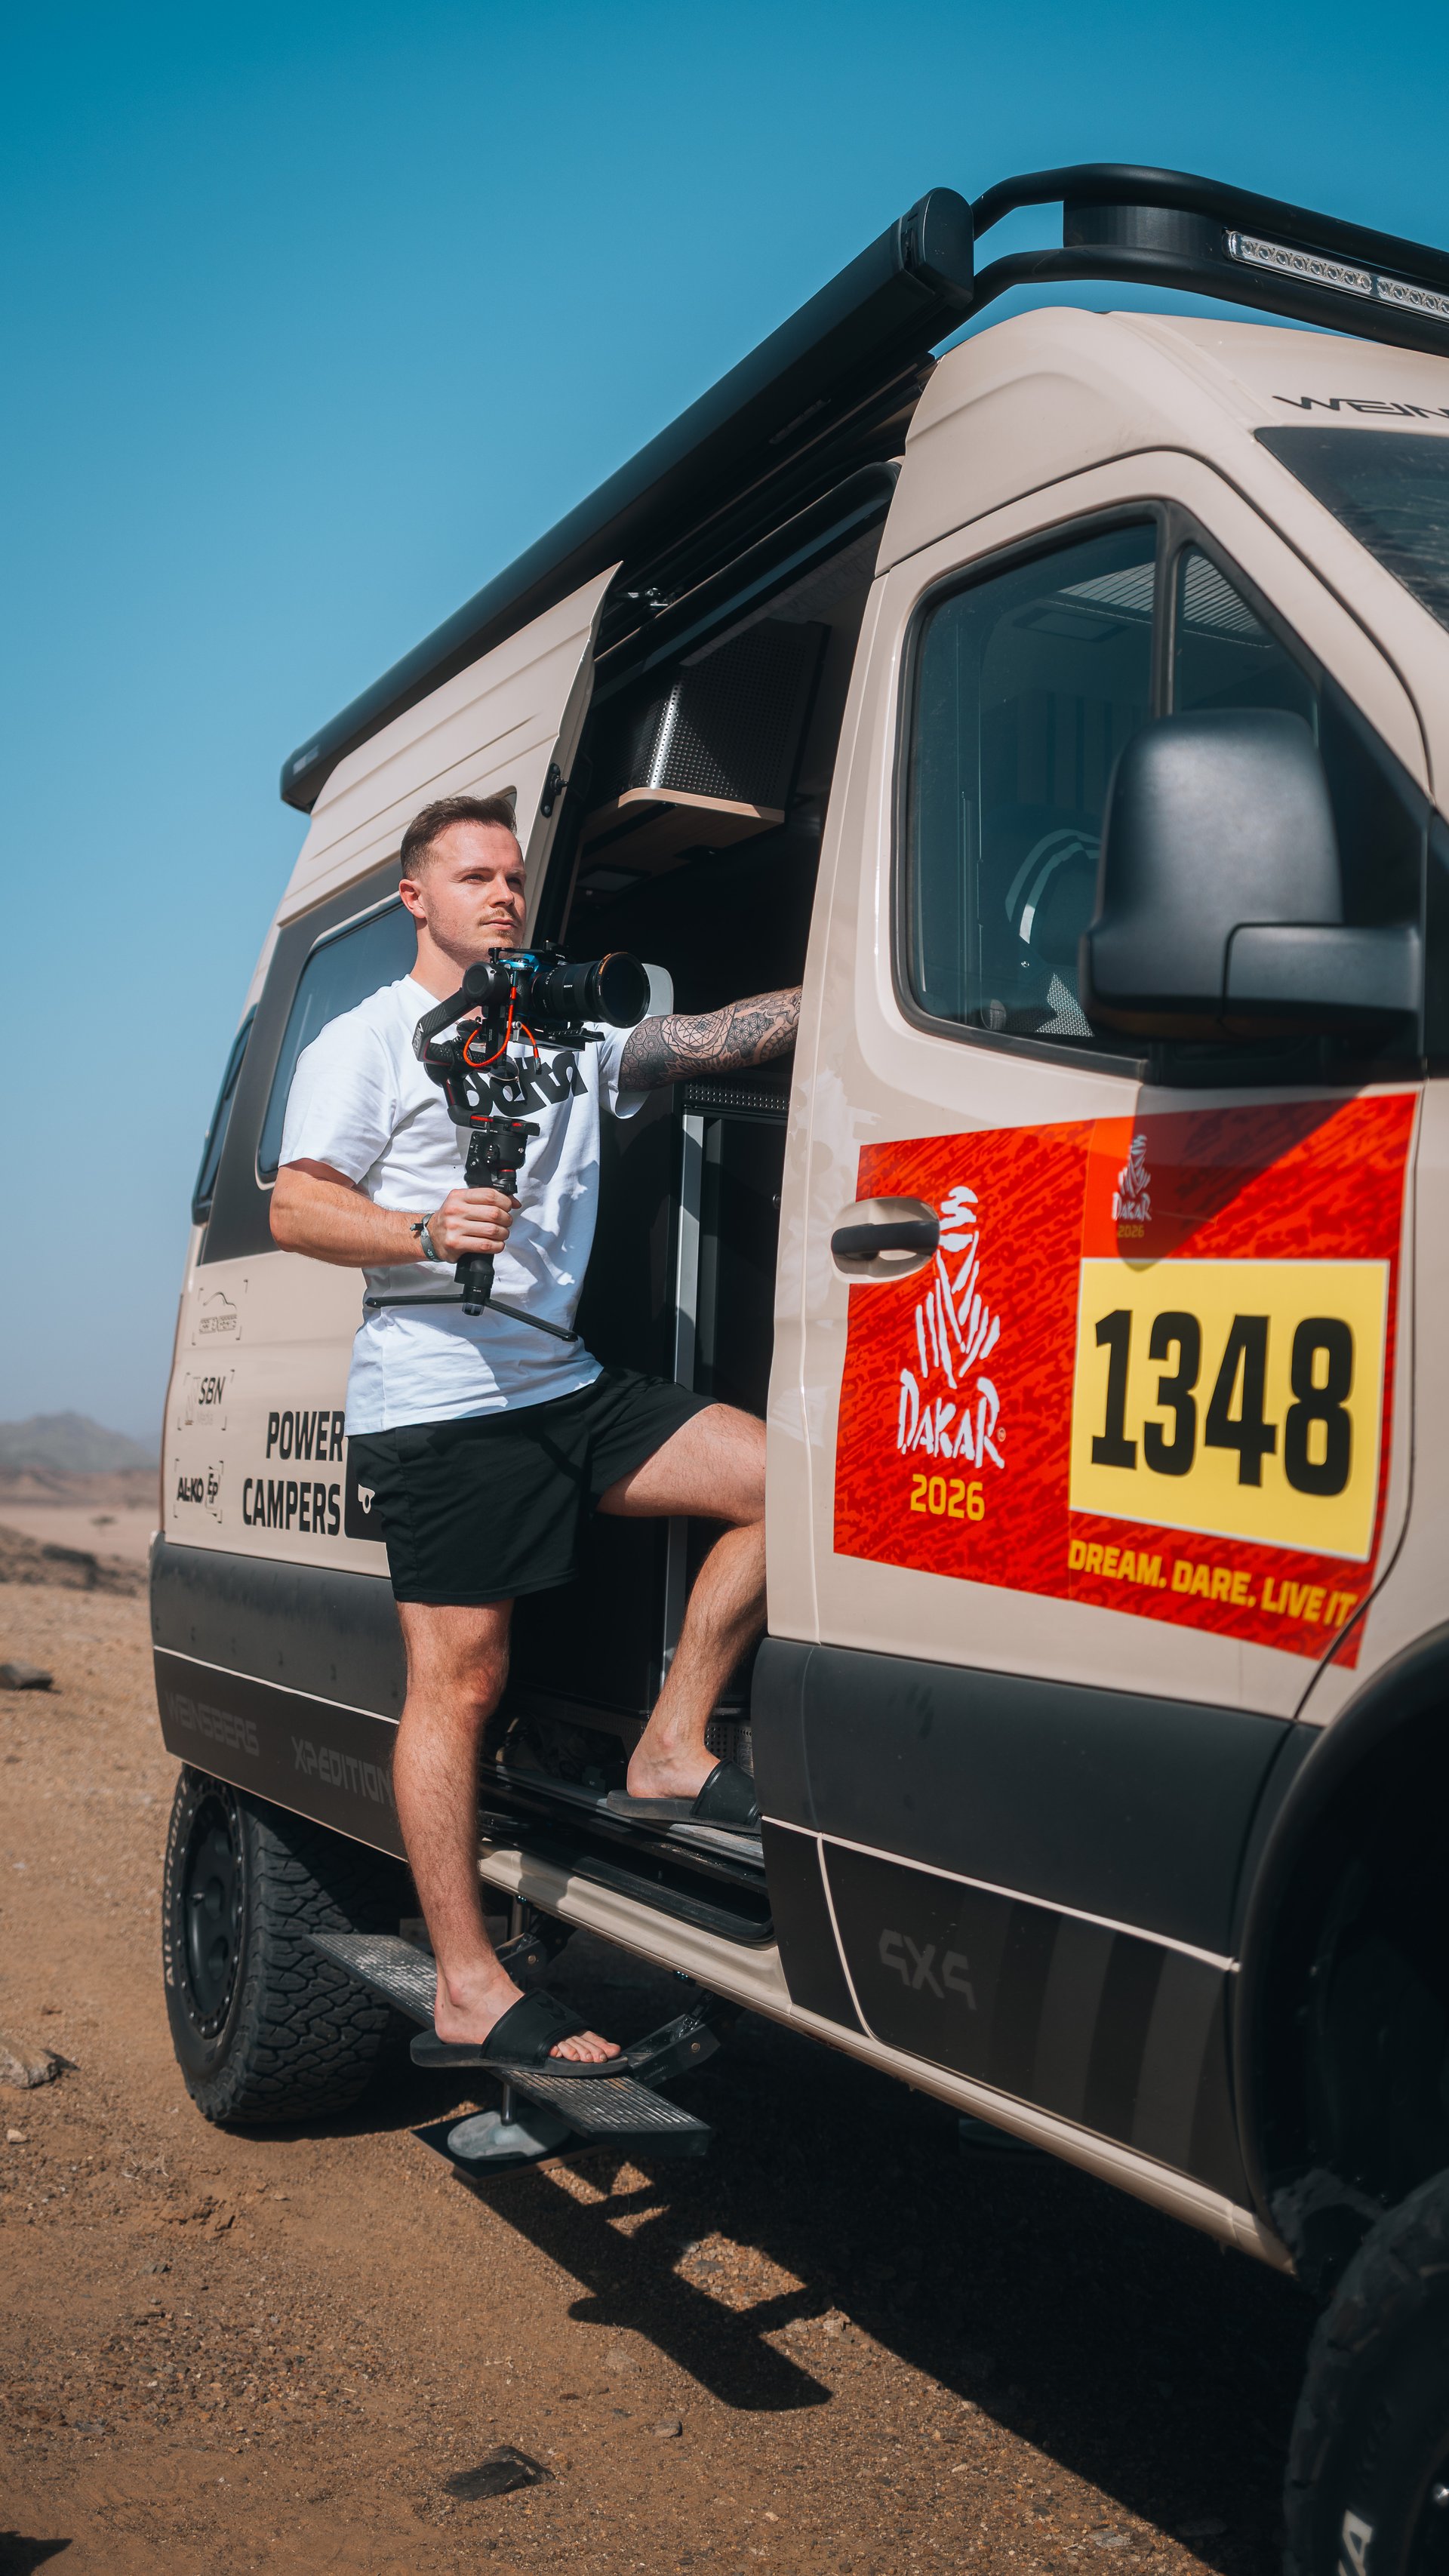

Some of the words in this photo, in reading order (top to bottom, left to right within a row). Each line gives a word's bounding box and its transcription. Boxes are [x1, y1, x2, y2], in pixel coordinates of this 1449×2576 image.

[1112, 1191, 1152, 1222] DAKAR
[1117, 1224, 1145, 1239] 2026
[198, 1375, 226, 1405] SBN
[897, 1368, 1005, 1470] DAKAR
[1090, 1308, 1354, 1497] 1348
[266, 1410, 346, 1462] POWER
[242, 1477, 341, 1536] CAMPERS
[910, 1473, 986, 1522] 2026
[1067, 1538, 1167, 1589] DREAM.
[1171, 1559, 1257, 1608] DARE.
[1260, 1576, 1327, 1623] LIVE
[164, 1690, 260, 1758] WEINSBERG
[291, 1735, 395, 1808] XPEDITION
